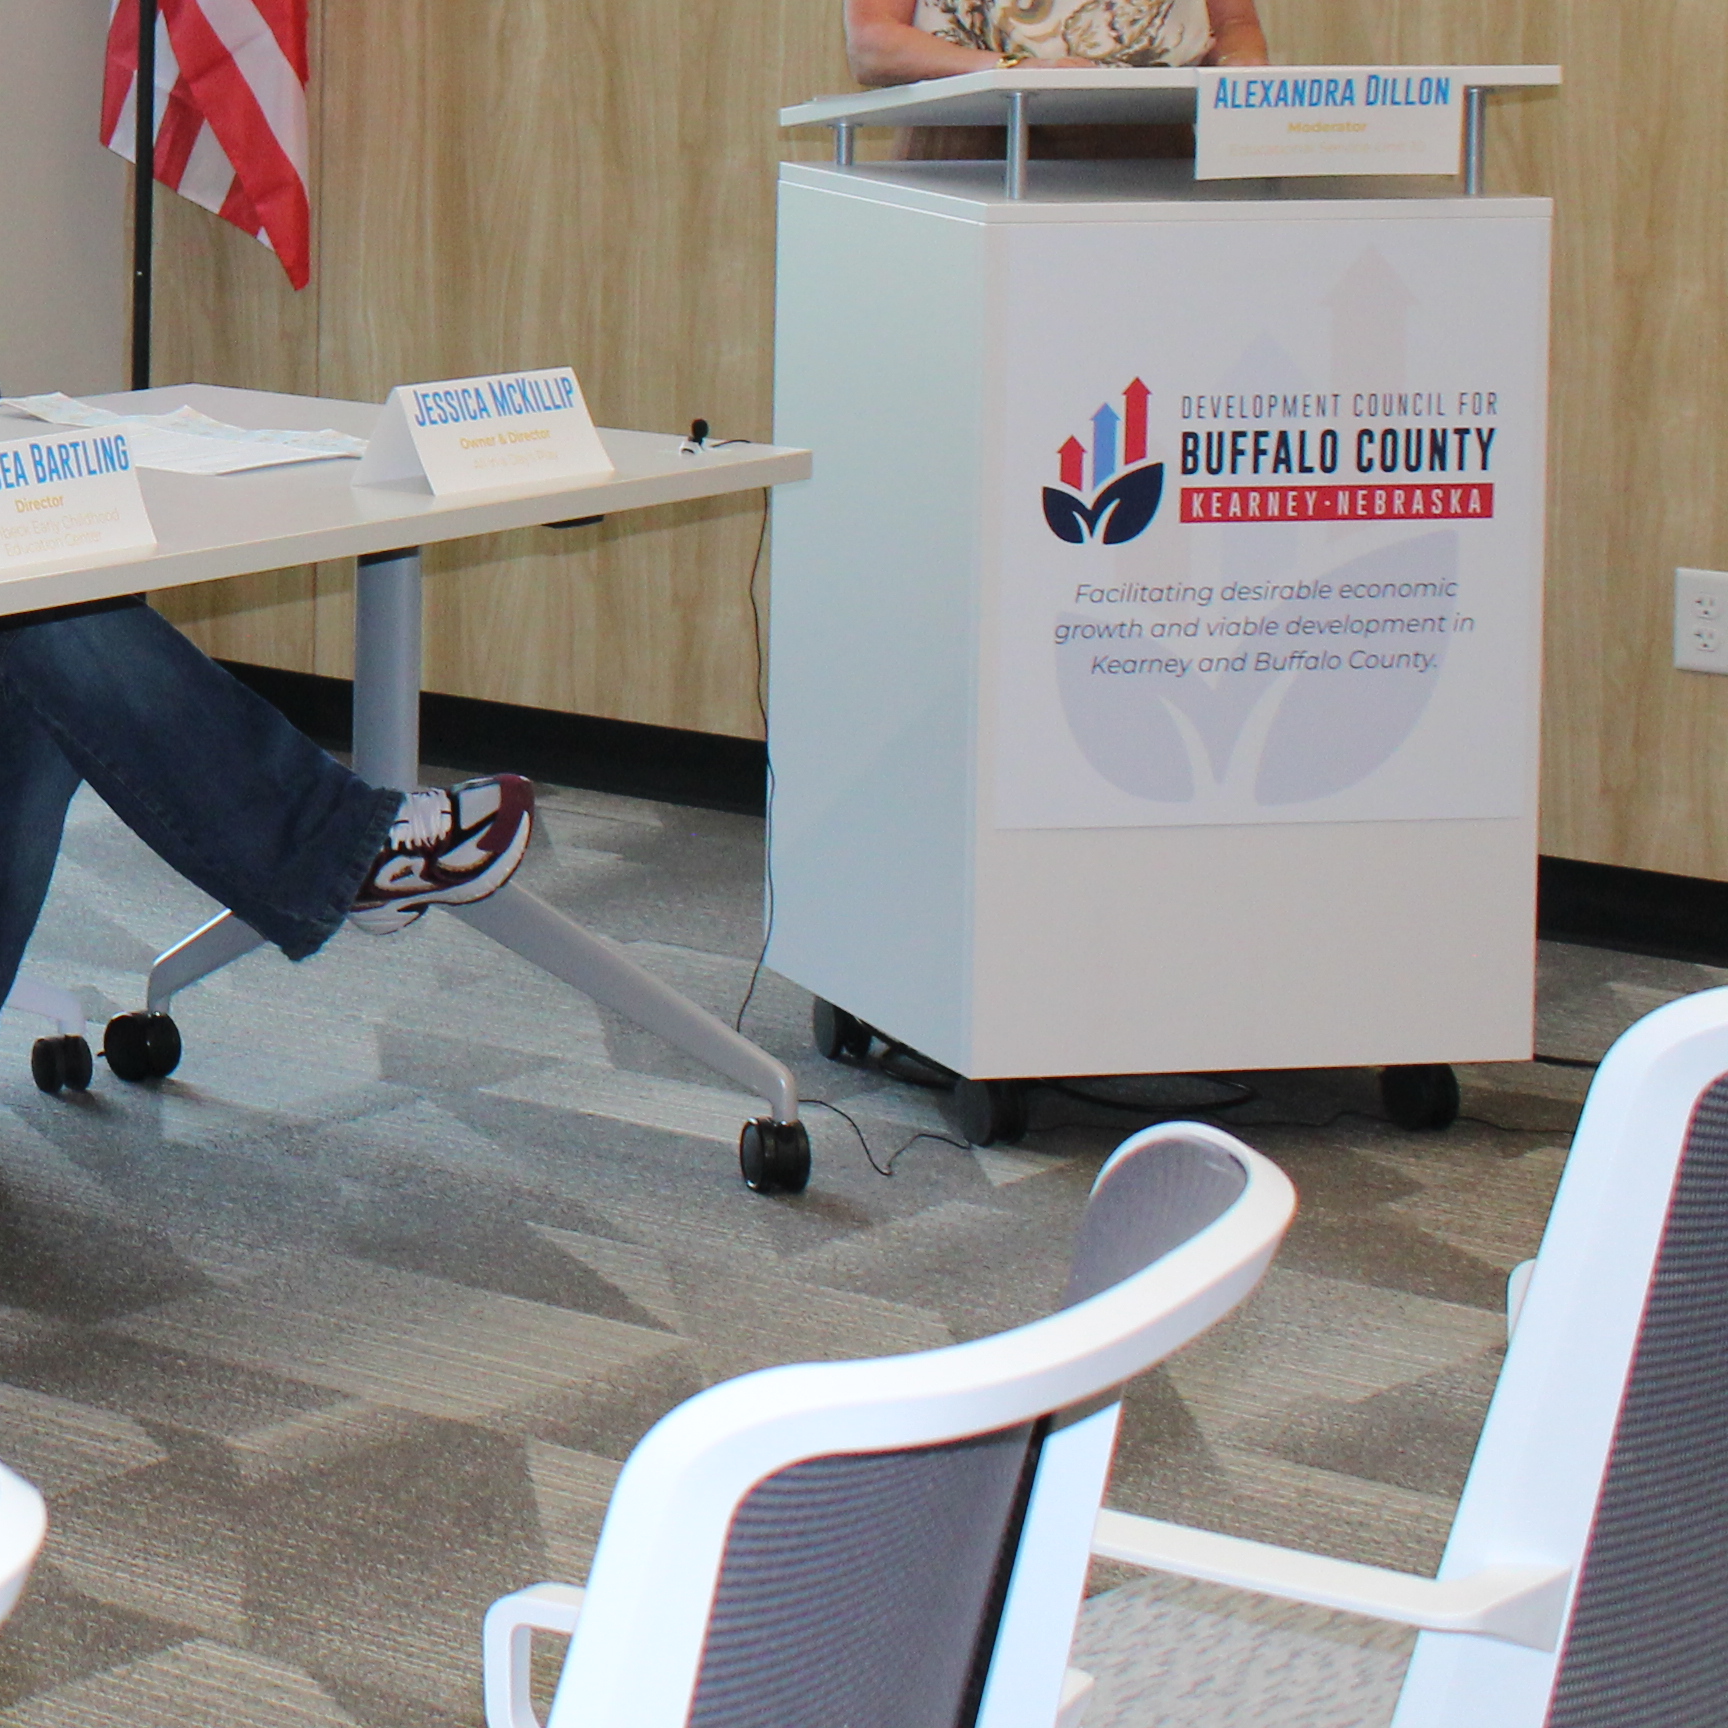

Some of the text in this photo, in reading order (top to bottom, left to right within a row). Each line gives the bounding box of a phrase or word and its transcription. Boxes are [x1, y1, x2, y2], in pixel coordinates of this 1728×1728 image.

[1214, 74, 1450, 109] ALEXANDRA DILLON
[1287, 121, 1368, 134] Moderator
[412, 387, 491, 427] JESSICA
[1181, 392, 1498, 419] DEVELOPMENT COUNCIL FOR
[459, 428, 551, 450] Owner & Director
[1181, 427, 1497, 475] BUFFALO COUNTY
[29, 434, 131, 484] BARTLING
[15, 494, 65, 513] Director
[33, 519, 60, 535] Early
[1075, 577, 1458, 607] Facilitating desirable economic
[1055, 612, 1475, 645] growth and viable development in
[1091, 649, 1439, 678] Kearney and Buffalo County.
